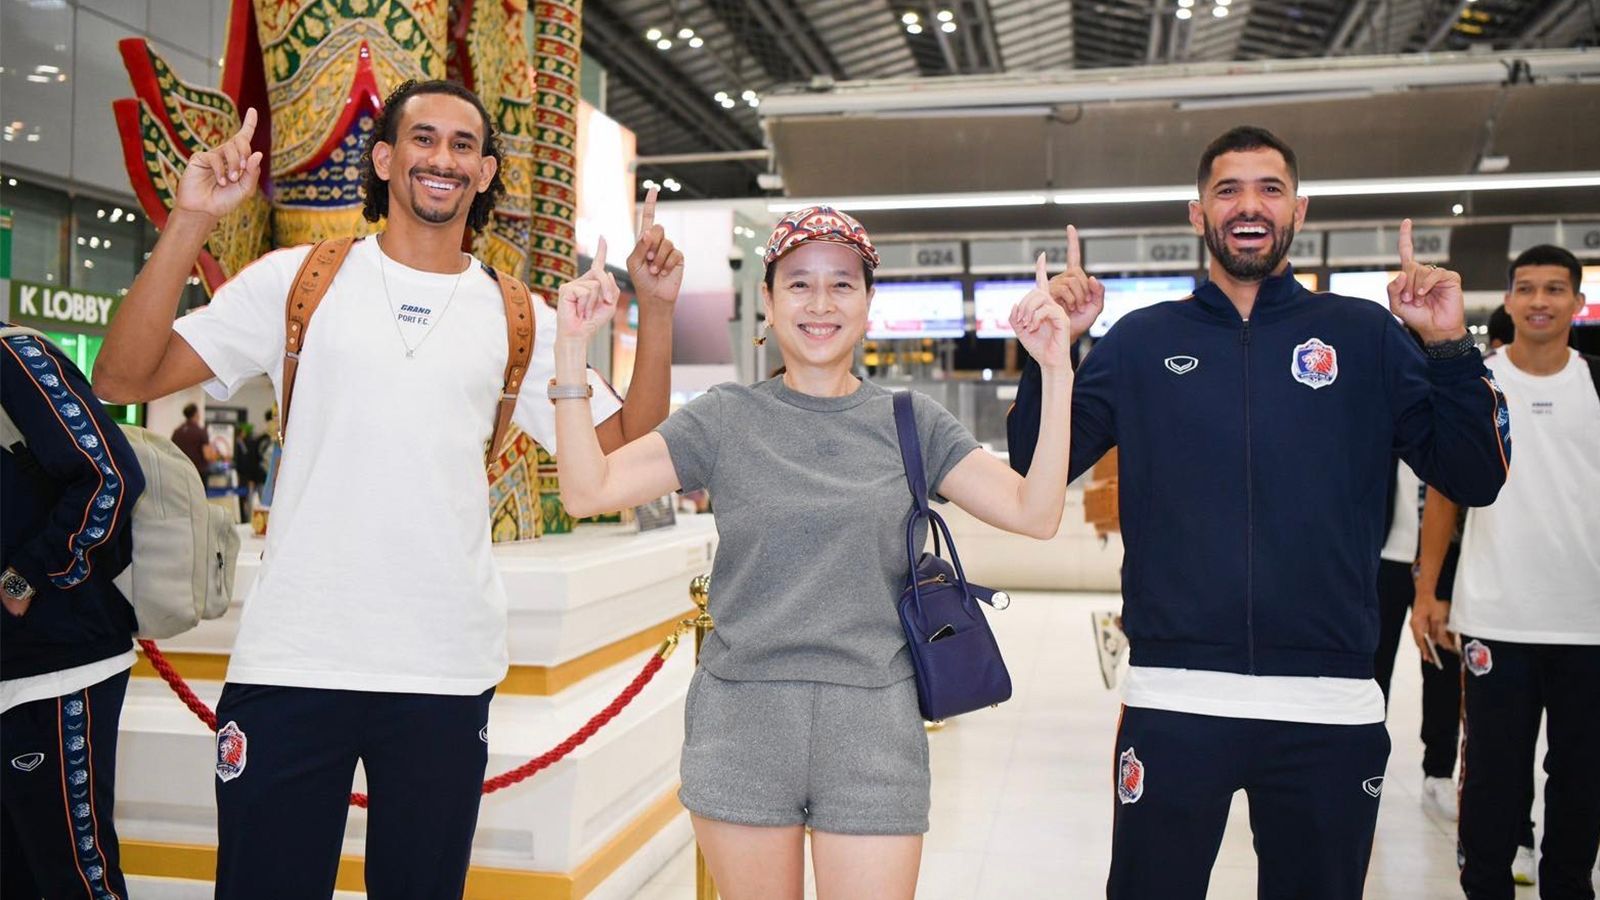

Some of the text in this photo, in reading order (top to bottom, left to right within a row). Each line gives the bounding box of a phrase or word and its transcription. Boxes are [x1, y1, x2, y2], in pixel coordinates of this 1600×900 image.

[1292, 240, 1315, 257] 21
[1416, 235, 1441, 253] 20
[917, 250, 954, 266] G24
[1151, 245, 1189, 261] G22
[20, 285, 112, 325] K LOBBY
[401, 304, 431, 315] GRAND
[398, 313, 416, 323] PORT
